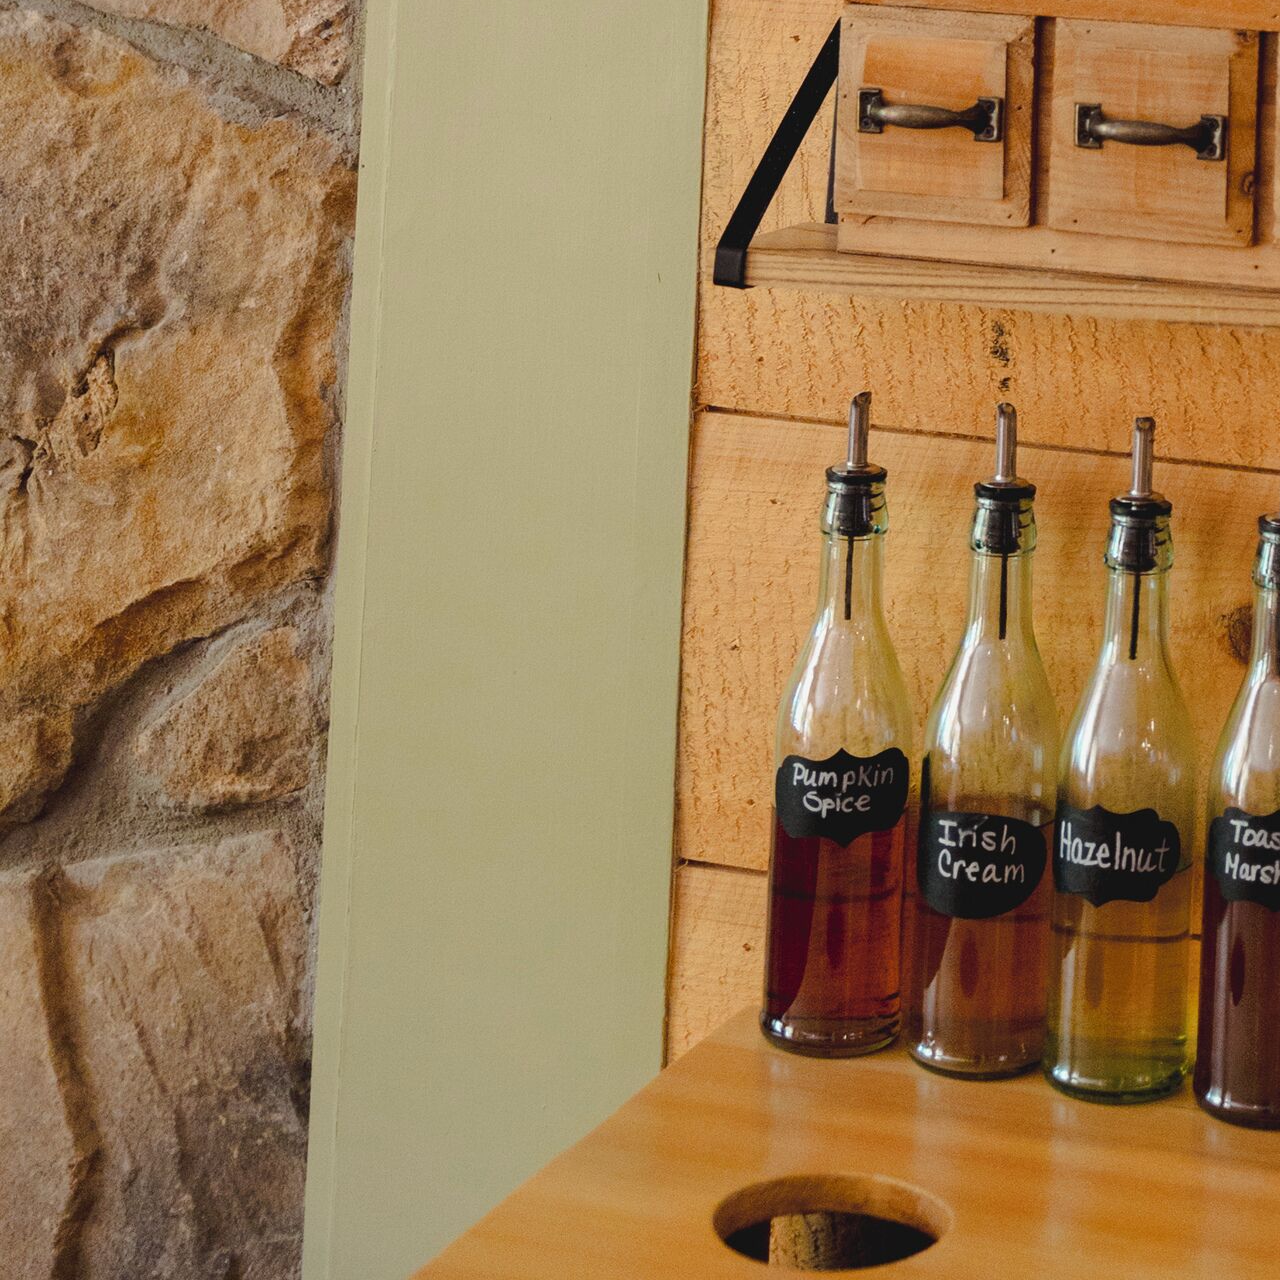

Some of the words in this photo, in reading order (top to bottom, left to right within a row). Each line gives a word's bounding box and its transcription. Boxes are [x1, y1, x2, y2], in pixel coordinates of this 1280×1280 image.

[792, 762, 895, 792] Pumpkin
[802, 791, 872, 819] Spice
[938, 819, 1017, 854] Irish
[1057, 819, 1170, 873] Hazelnut
[936, 849, 1026, 884] Cream
